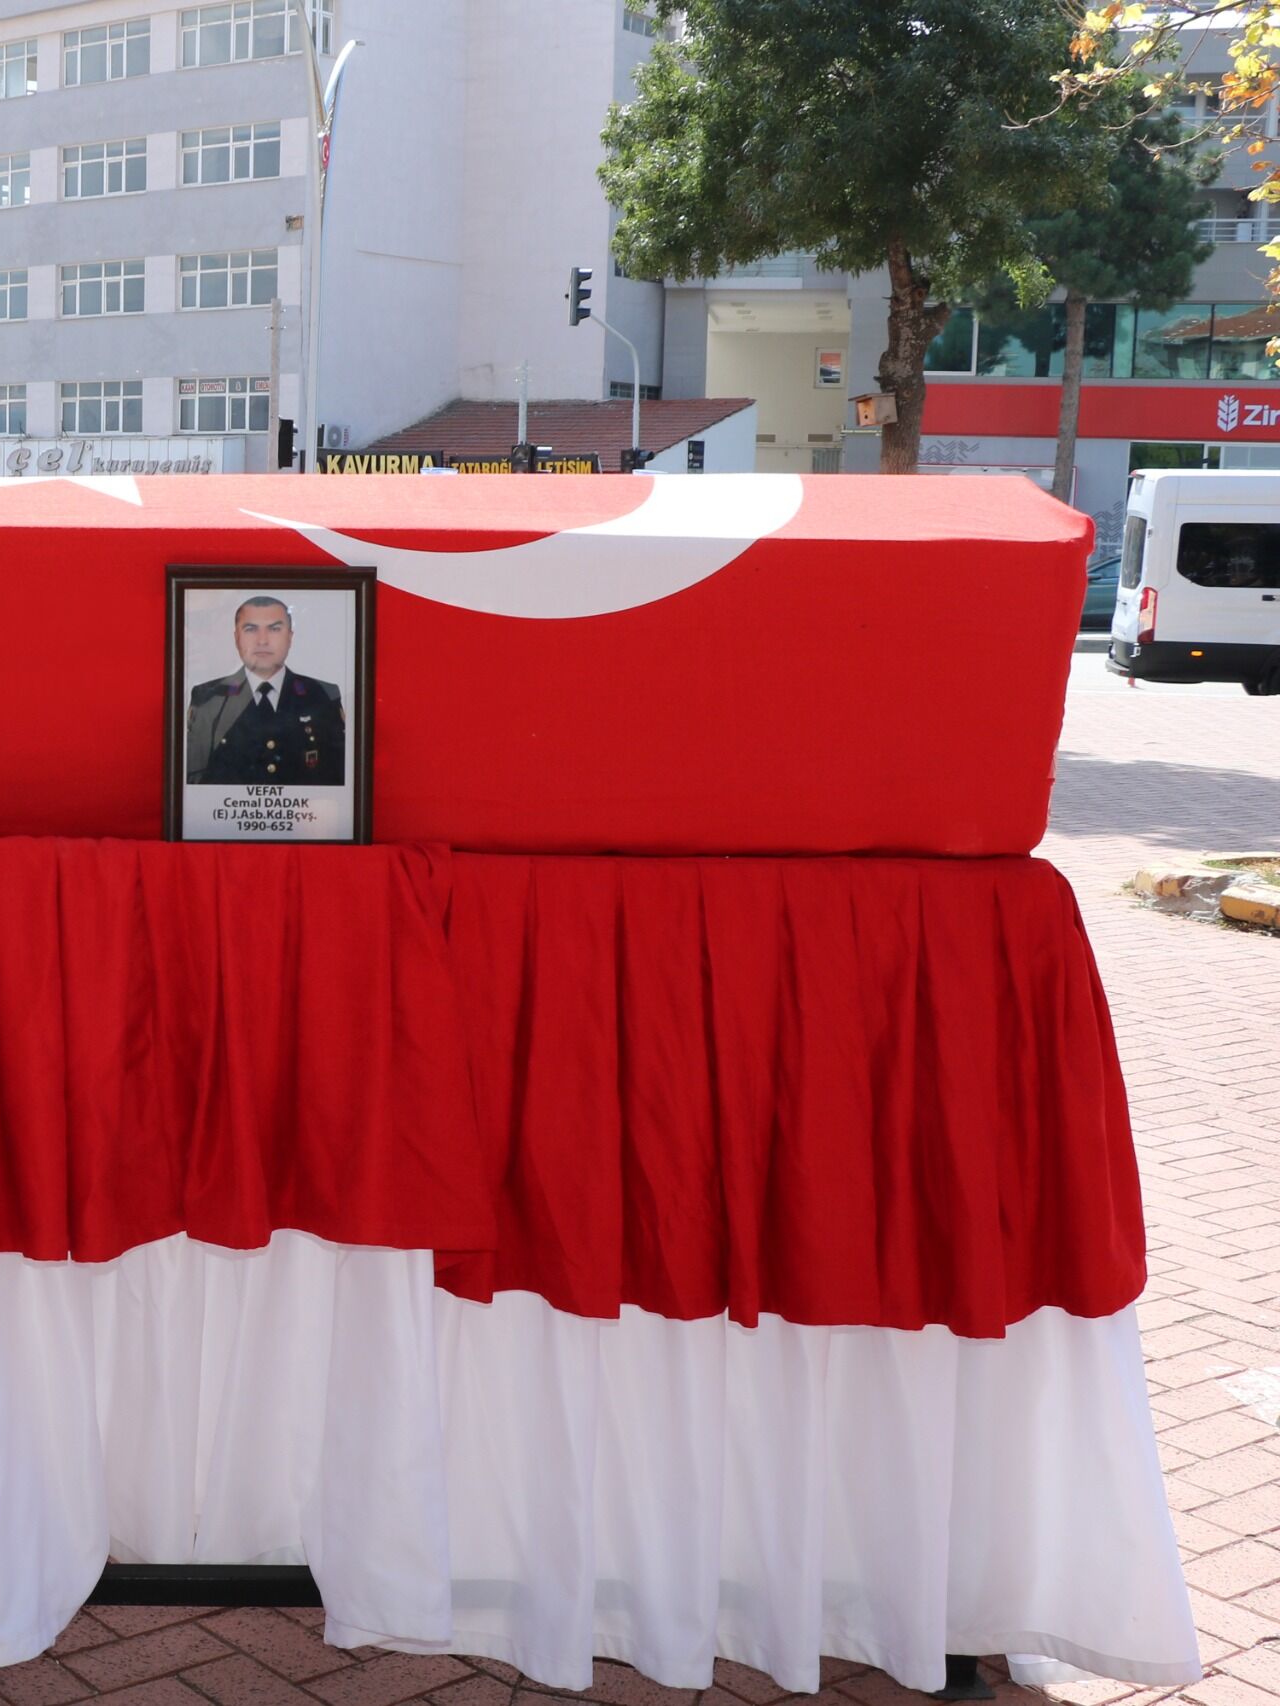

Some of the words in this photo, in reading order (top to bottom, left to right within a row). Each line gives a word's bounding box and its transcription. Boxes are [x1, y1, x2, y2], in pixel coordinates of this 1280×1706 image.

[326, 454, 435, 475] KAVURMA
[246, 786, 284, 796] VEFAT
[223, 797, 261, 808] Cemal
[264, 798, 309, 808] DADAK
[213, 809, 228, 820] (E)
[237, 821, 294, 831] 1990-652
